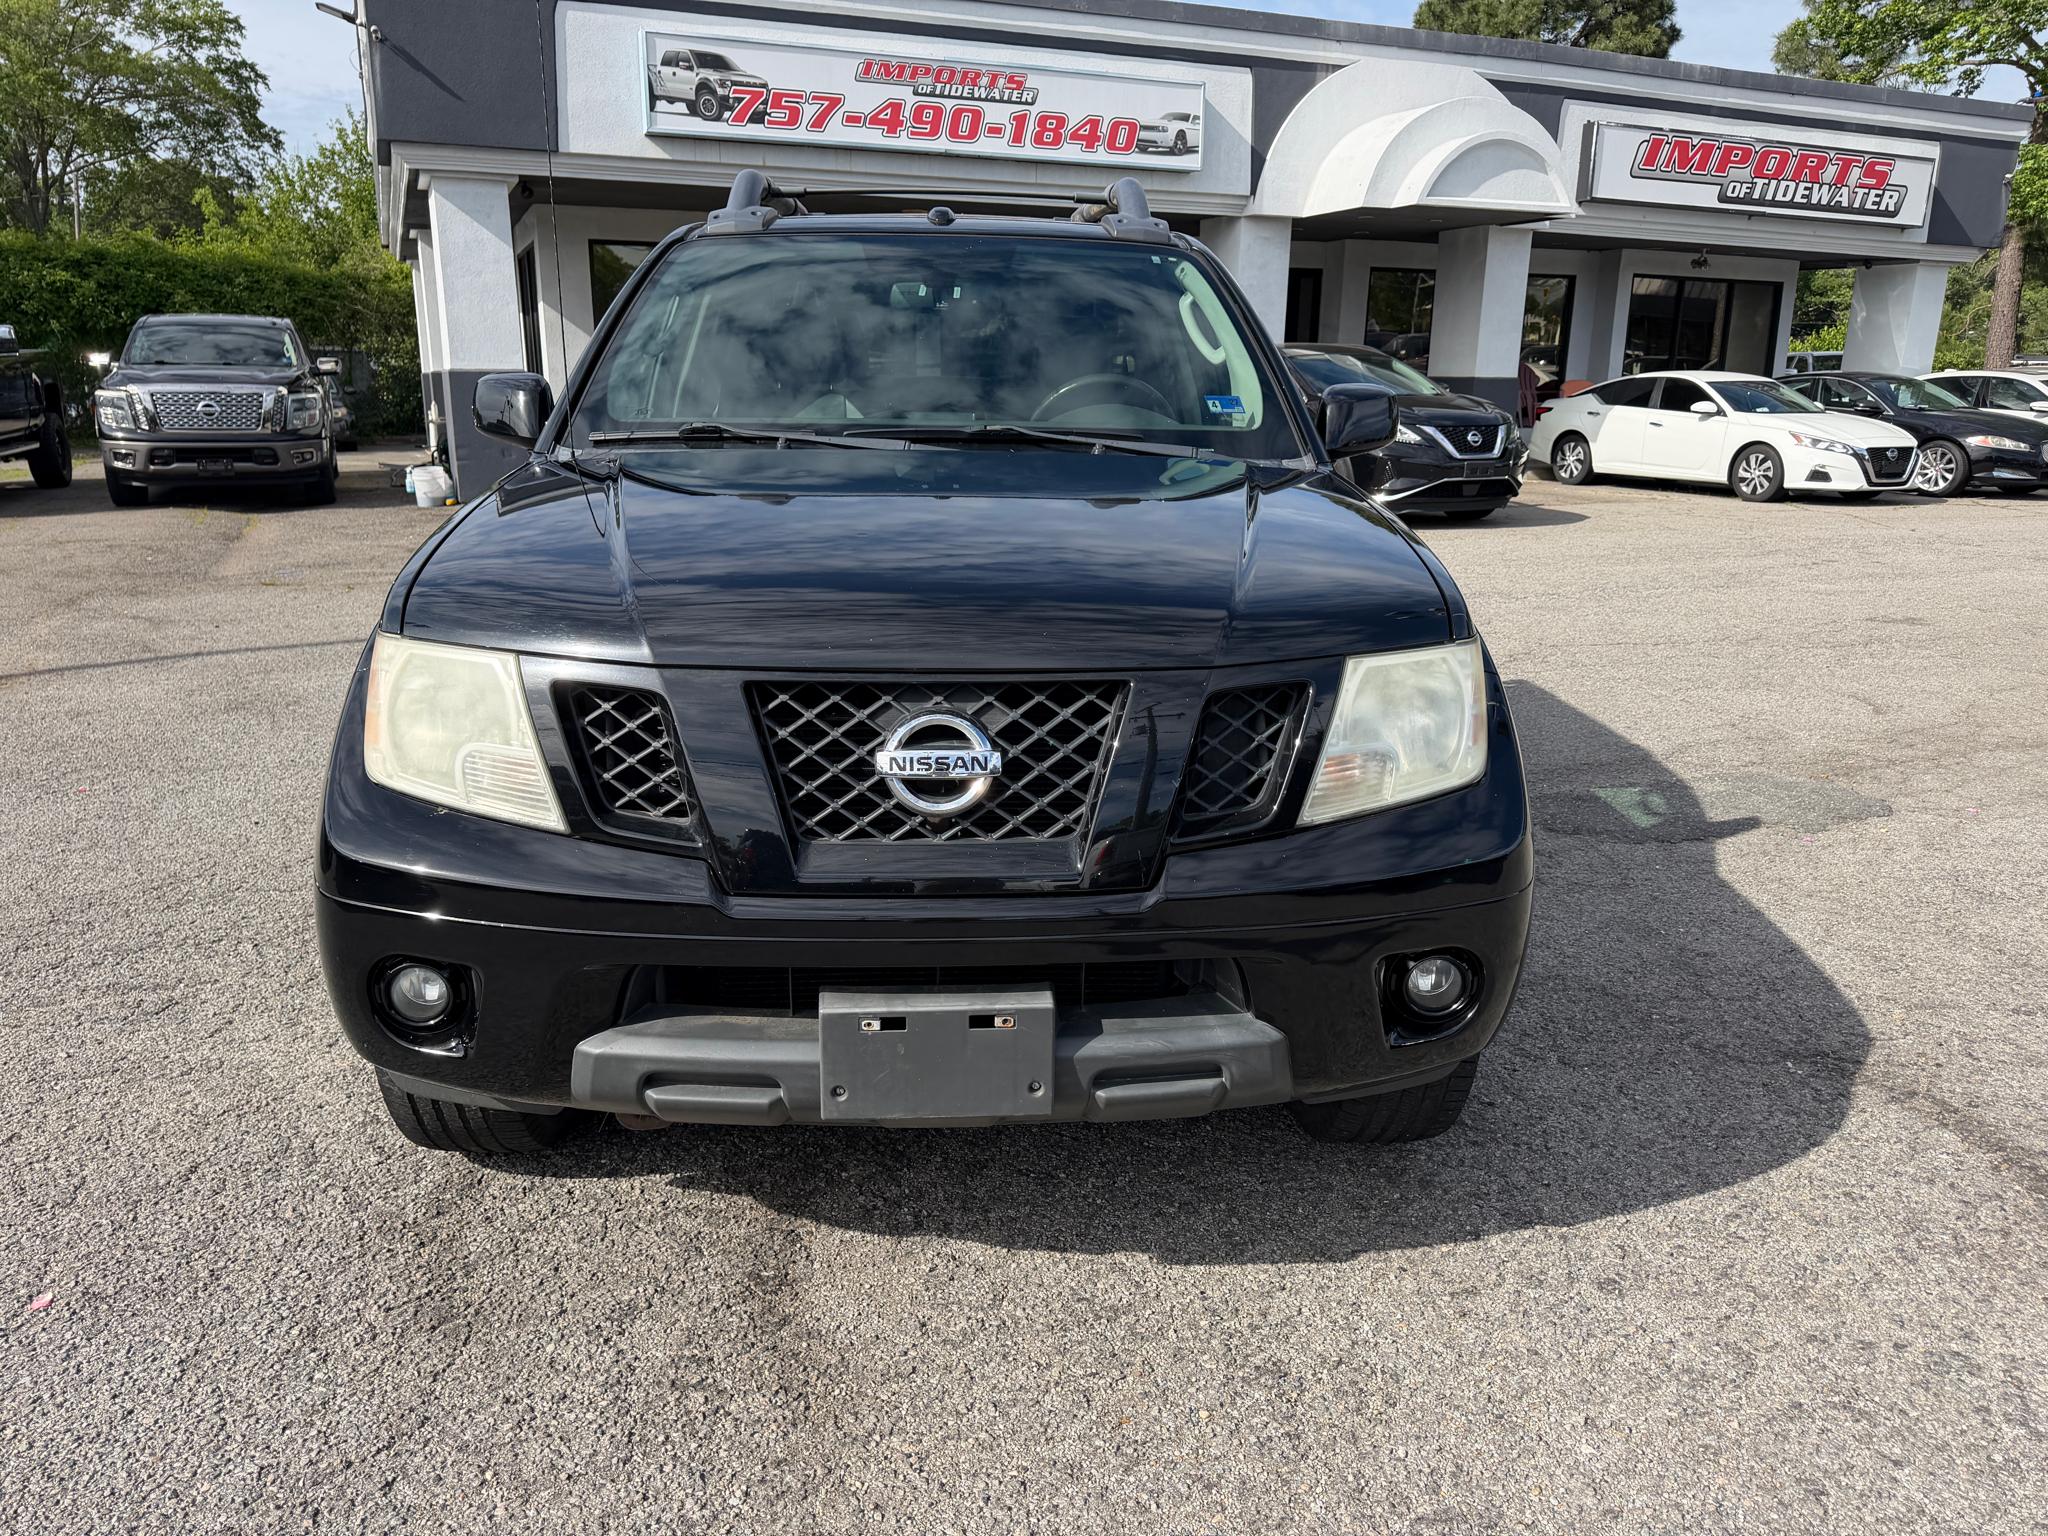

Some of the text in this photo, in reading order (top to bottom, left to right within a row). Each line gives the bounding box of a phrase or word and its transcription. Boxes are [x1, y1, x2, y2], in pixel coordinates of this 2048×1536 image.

[860, 59, 1028, 91] IMPORTS
[918, 82, 1035, 103] OF TIDEWATER
[727, 86, 1140, 154] 757-490-1840
[1639, 135, 1895, 189] IMPORTS
[1726, 178, 1900, 212] OF TIDEWATER
[889, 756, 988, 772] NISSAN
